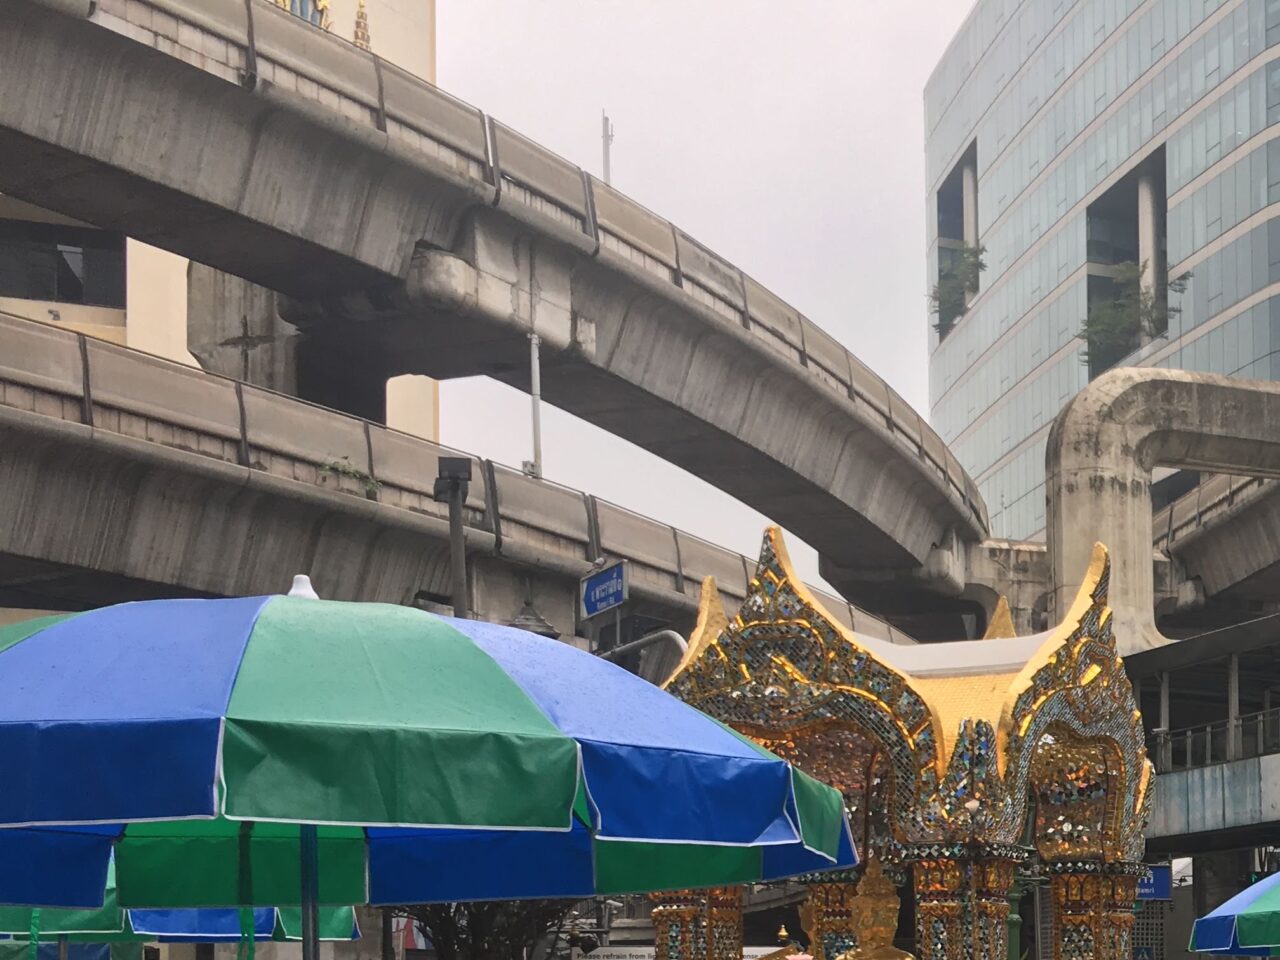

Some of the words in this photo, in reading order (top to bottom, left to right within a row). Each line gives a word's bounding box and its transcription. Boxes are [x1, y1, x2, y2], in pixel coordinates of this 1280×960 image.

[577, 952, 601, 960] Please
[602, 952, 627, 960] refrain
[629, 952, 646, 960] from
